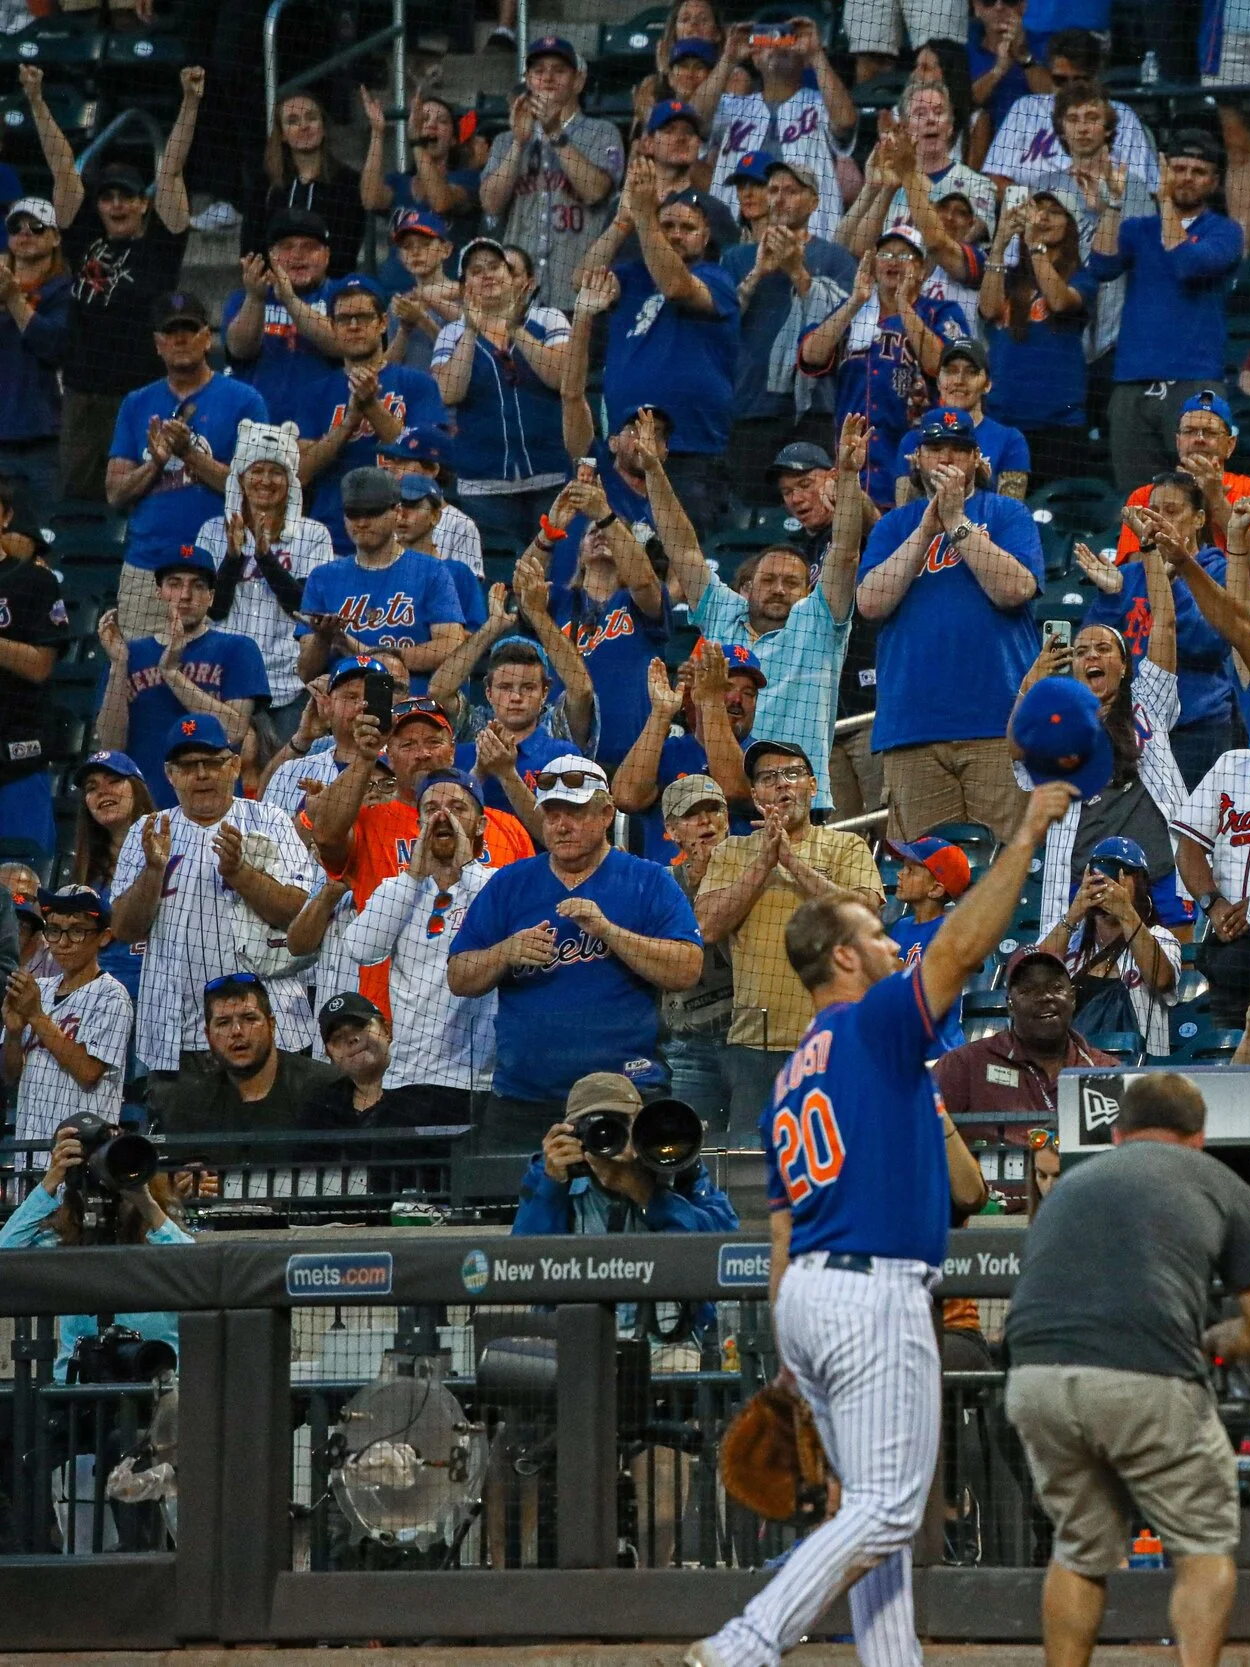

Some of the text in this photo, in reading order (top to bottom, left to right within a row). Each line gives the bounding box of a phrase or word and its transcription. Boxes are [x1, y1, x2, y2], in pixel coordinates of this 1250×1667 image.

[551, 204, 583, 233] 30
[338, 591, 416, 634] Mets
[773, 1087, 847, 1202] 20
[294, 1267, 387, 1286] mets.com
[494, 1256, 655, 1284] New York Lottery
[943, 1252, 1021, 1275] ew York
